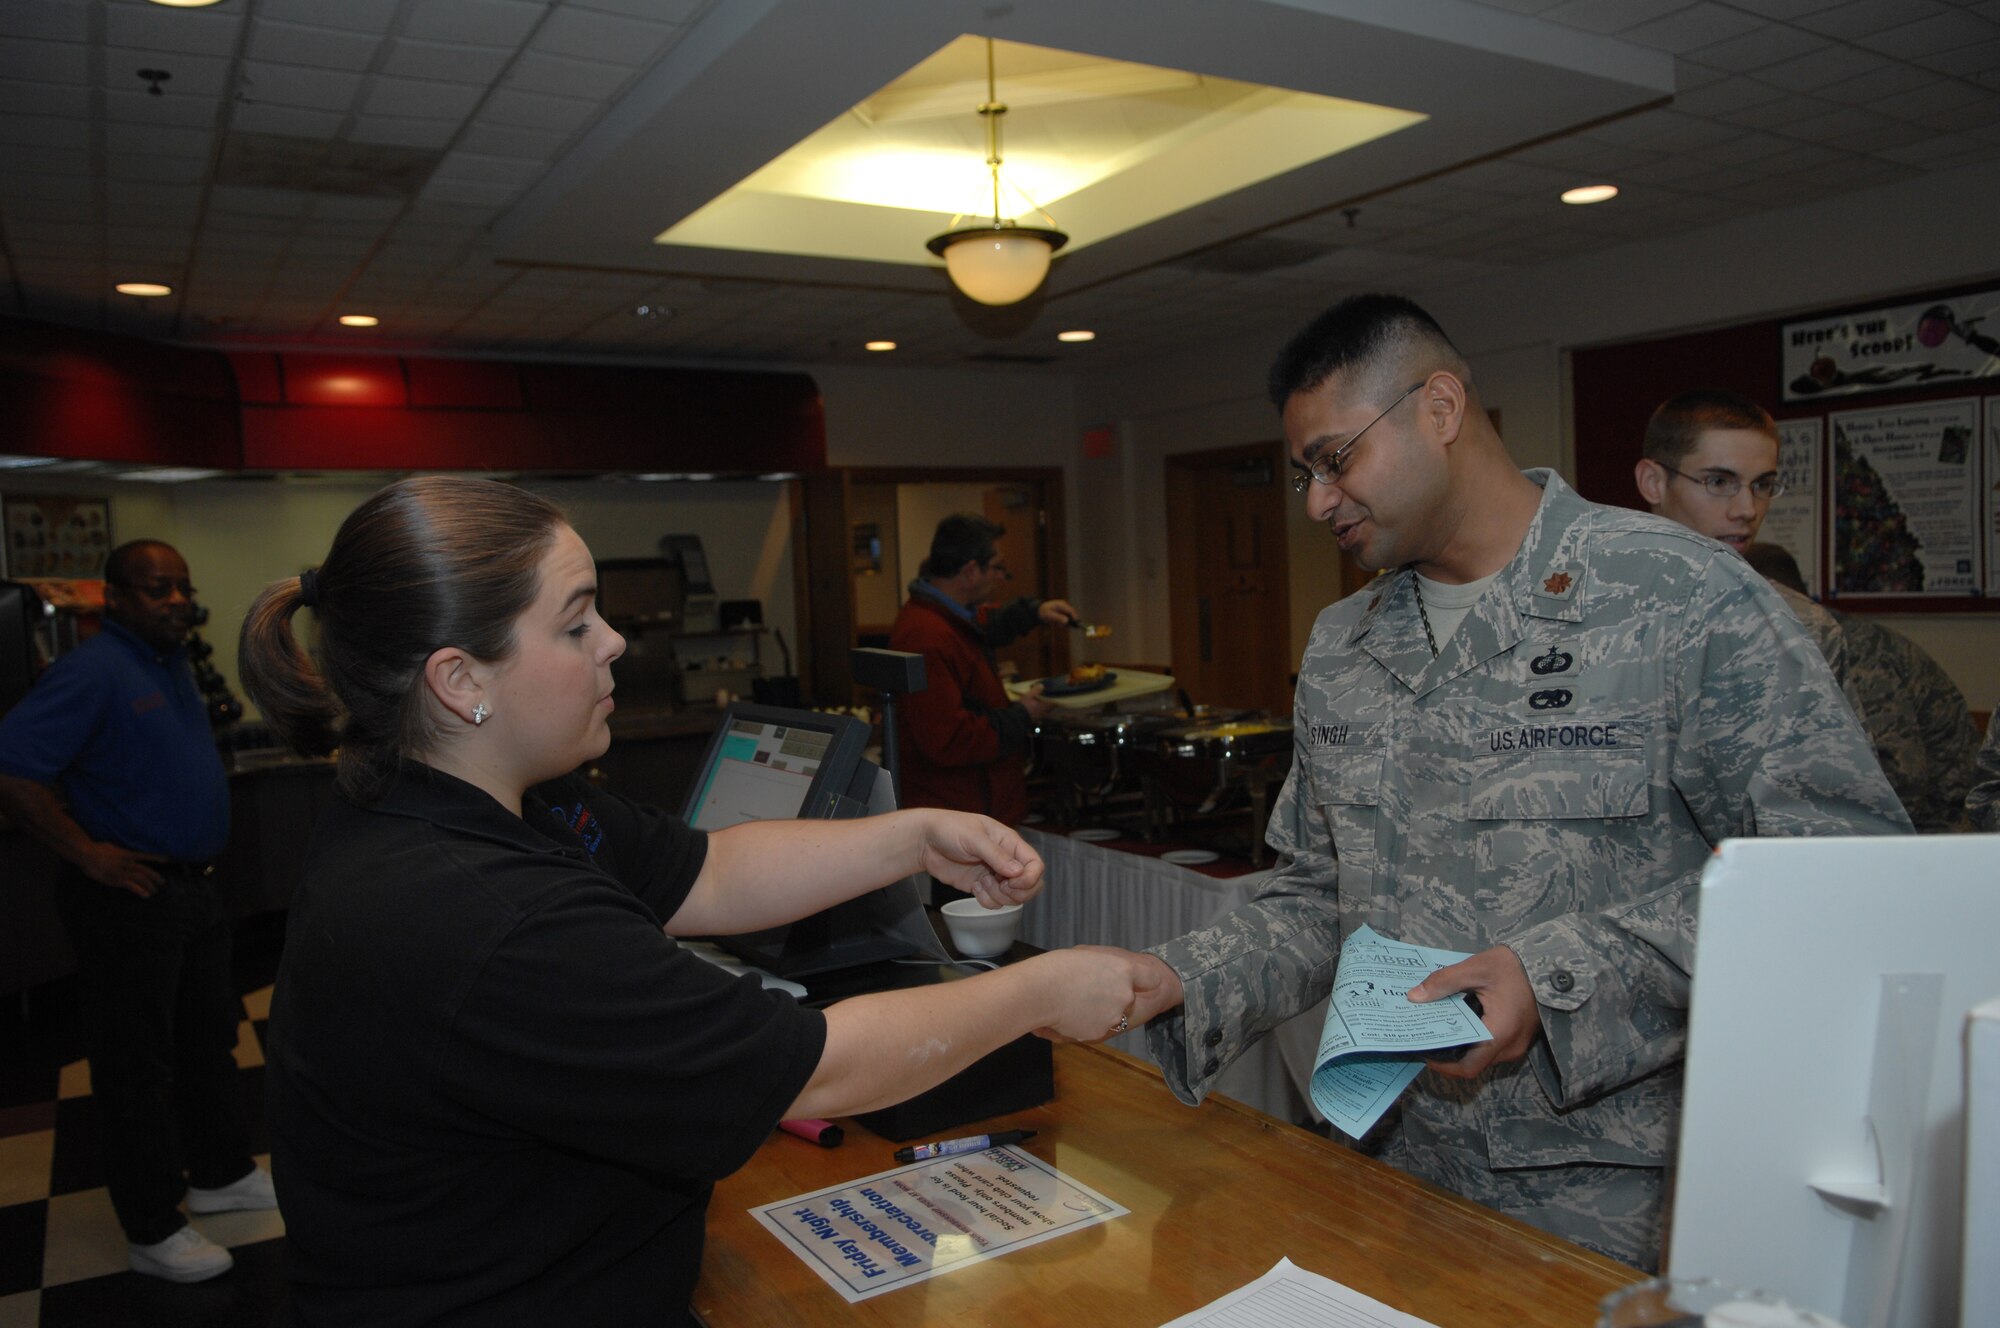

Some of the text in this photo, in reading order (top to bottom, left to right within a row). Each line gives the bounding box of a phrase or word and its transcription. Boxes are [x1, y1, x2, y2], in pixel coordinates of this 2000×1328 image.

[1311, 725, 1348, 745] SINGH
[930, 1176, 943, 1184] for
[995, 1175, 1039, 1201] requested.
[945, 1171, 1031, 1225] members only. Please
[948, 1188, 969, 1201] food
[953, 1163, 1055, 1225] show your club card when
[967, 1200, 988, 1213] hour
[984, 1212, 1014, 1230] Social
[793, 1208, 886, 1278] Friday Night
[829, 1199, 921, 1267] Membership
